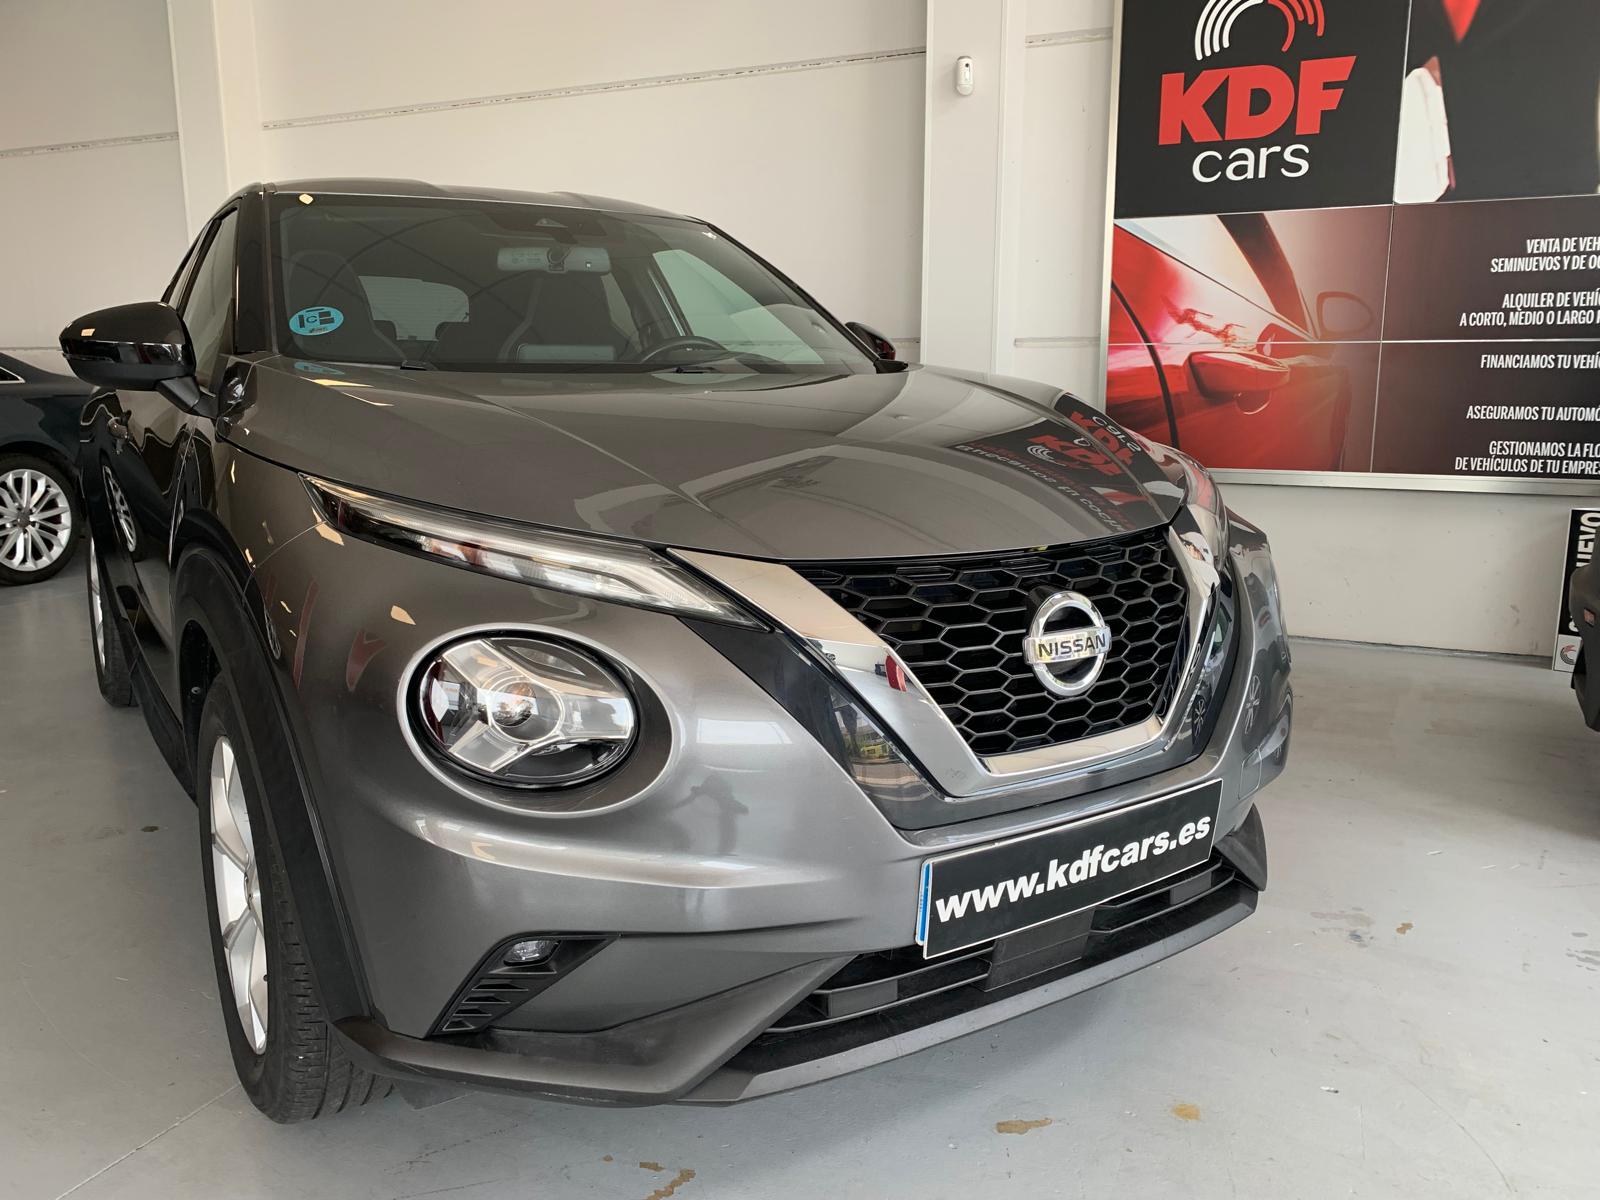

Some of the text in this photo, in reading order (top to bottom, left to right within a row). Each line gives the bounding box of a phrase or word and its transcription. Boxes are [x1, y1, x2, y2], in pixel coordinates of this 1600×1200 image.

[1158, 55, 1357, 146] KDF
[1192, 143, 1310, 183] cars
[1526, 238, 1560, 254] VENTA
[1561, 237, 1578, 253] DE
[1490, 255, 1561, 273] SEMINUEVOS
[1562, 255, 1571, 271] Y
[1571, 254, 1587, 270] DE
[1502, 287, 1600, 312] ALQUILER DE VEHÍ
[1459, 312, 1468, 327] A
[1468, 311, 1507, 328] CORTO,
[1508, 310, 1545, 326] MEDIO
[1546, 310, 1555, 325] O
[1556, 309, 1595, 325] LARGO
[1480, 350, 1600, 369] FINANCIAMOS TU VEHÍ
[1466, 405, 1540, 421] ASEGURAMOS
[1541, 406, 1556, 421] TU
[1489, 440, 1566, 457] GESTIONAMOS
[1567, 442, 1581, 458] LA
[1455, 456, 1468, 471] DE
[1470, 454, 1529, 473] VEHÍCULOS
[1529, 459, 1545, 473] DE
[1546, 459, 1560, 473] TU
[1038, 633, 1106, 657] NISSAN
[935, 815, 1211, 923] www.kdfcars.es
